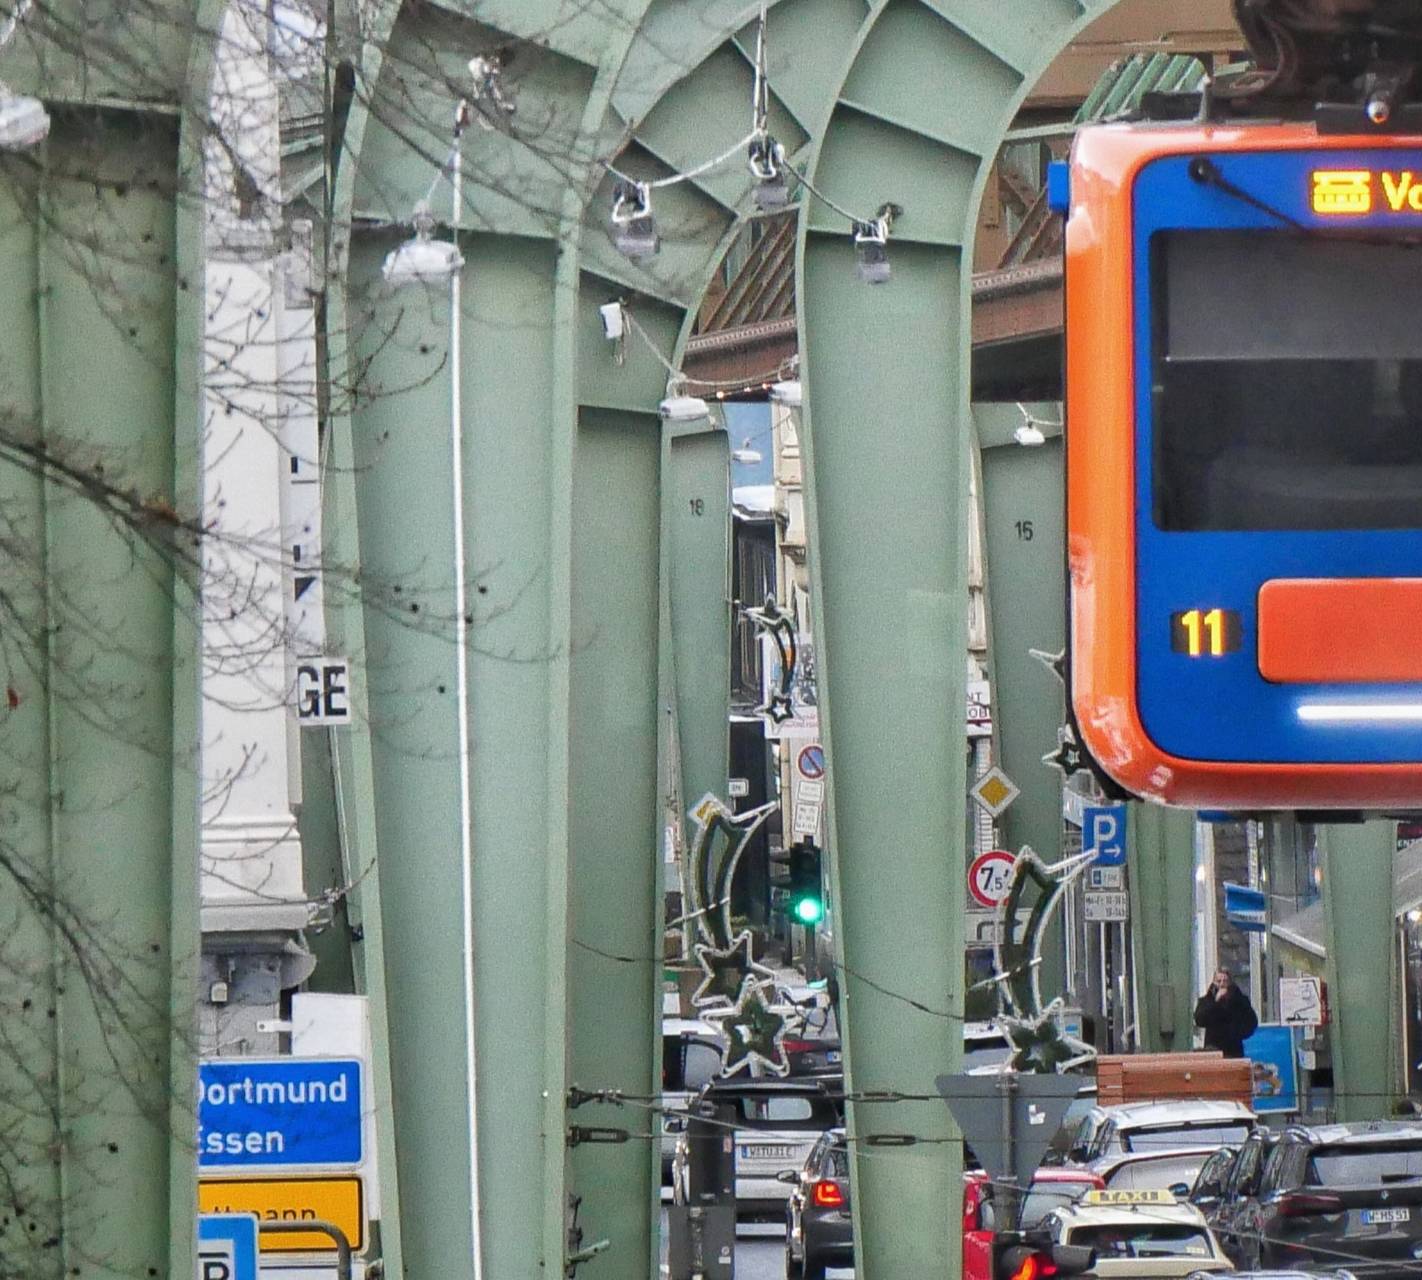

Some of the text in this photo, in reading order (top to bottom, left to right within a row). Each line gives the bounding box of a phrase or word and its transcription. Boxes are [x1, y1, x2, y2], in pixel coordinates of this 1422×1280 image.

[1181, 609, 1225, 657] 11
[297, 664, 348, 718] GE
[1093, 814, 1117, 855] P
